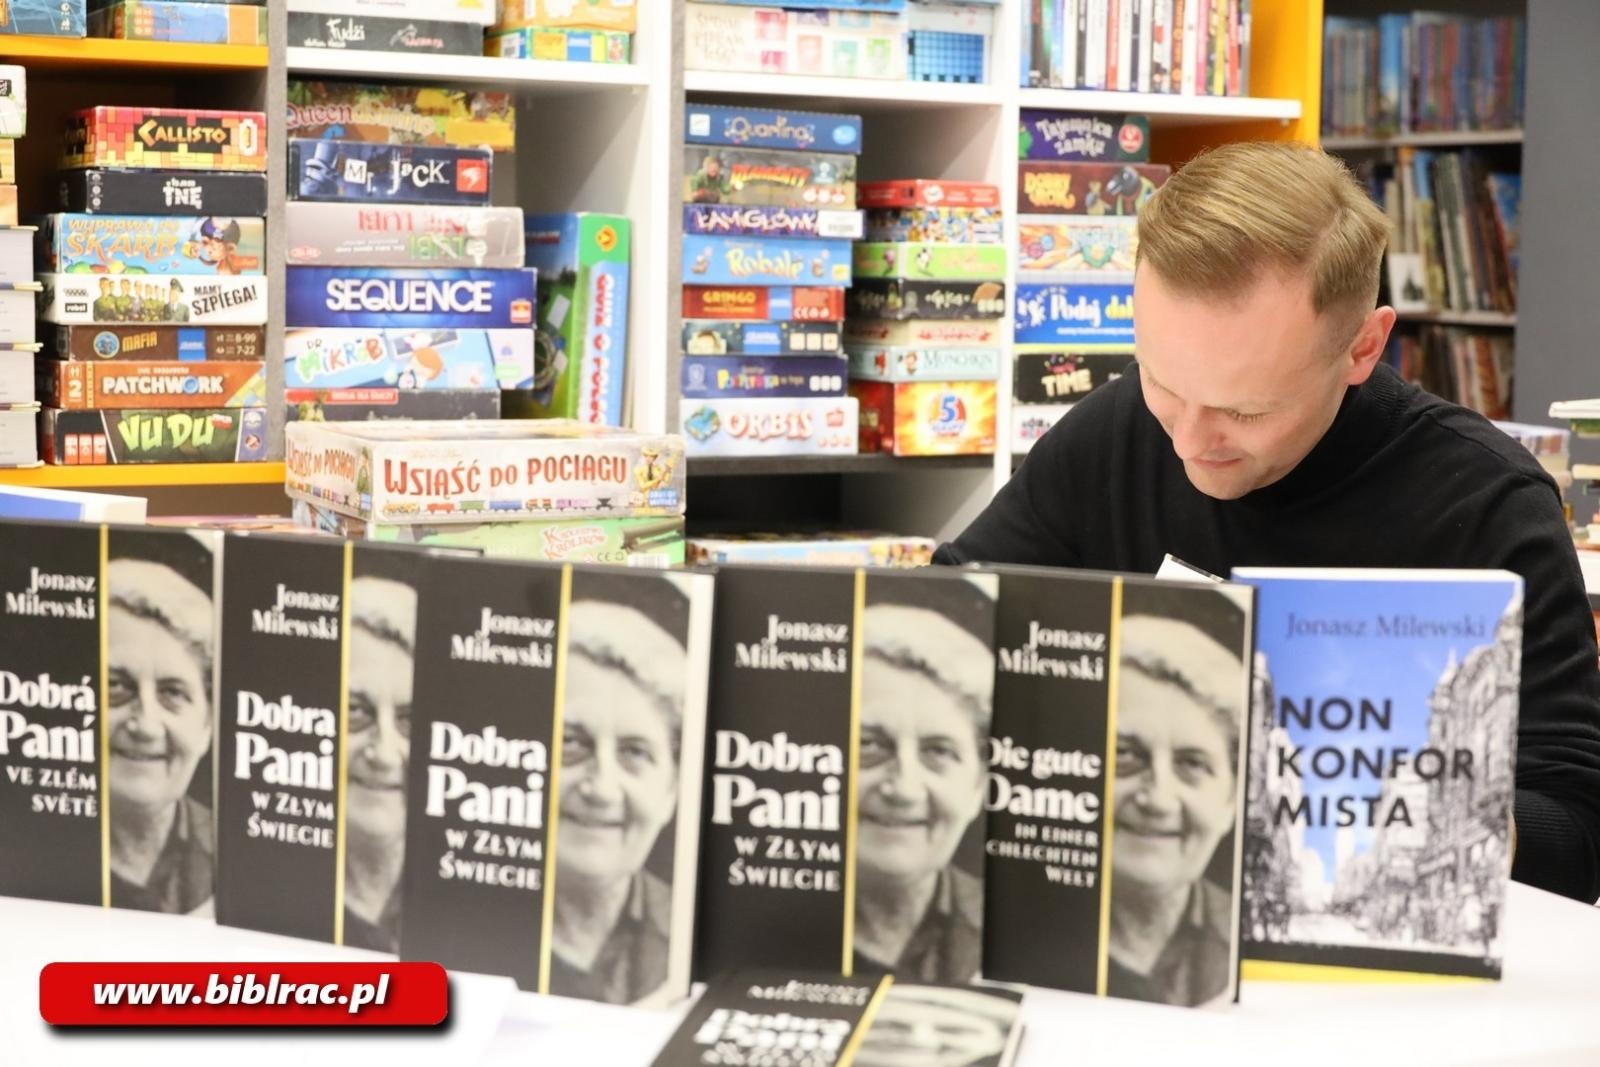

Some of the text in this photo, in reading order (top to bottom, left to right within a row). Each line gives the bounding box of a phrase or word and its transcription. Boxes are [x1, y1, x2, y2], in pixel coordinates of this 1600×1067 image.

[138, 119, 227, 147] CALLISTO
[66, 231, 179, 263] SKARB
[191, 285, 258, 316] SZPIEGA!
[194, 285, 221, 296] MAMY
[326, 278, 493, 313] SEQUENCE
[122, 331, 158, 353] MAFIA
[68, 379, 82, 398] 2
[103, 375, 224, 395] PATCHWORK
[1041, 368, 1093, 397] TIME
[940, 395, 956, 422] 5
[725, 410, 814, 441] ORBIS
[527, 454, 627, 485] POCIĄGU
[30, 566, 96, 593] Jonasz
[5, 592, 95, 620] Milewski
[276, 583, 340, 612] Jonasz
[252, 609, 339, 640] Milewski
[480, 607, 555, 638] Jonasz
[767, 614, 848, 645] Jonasz
[1029, 620, 1106, 652] Jonasz
[1286, 611, 1486, 639] Jonasz Milewski
[450, 633, 553, 669] Milewski
[735, 641, 848, 673] Milewski
[999, 647, 1104, 681] Milewski
[0, 670, 96, 712] Dobrá
[237, 690, 336, 738] Dobra
[1279, 697, 1393, 732] NON
[0, 709, 96, 763] Paní
[430, 721, 548, 772] Dobra
[234, 731, 335, 790] Pani
[714, 730, 844, 775] Dobra
[1031, 747, 1102, 780] gute
[1277, 746, 1474, 781] KONFOR
[6, 765, 97, 792] VE ZLÉM
[276, 795, 335, 820] ZŁYM
[425, 765, 545, 829] Pani
[711, 774, 841, 831] Pani
[984, 771, 1100, 824] Dame
[1272, 795, 1413, 828] MISTA
[247, 815, 335, 848] ŚWIECIE
[473, 830, 542, 861] ZŁYM
[1041, 825, 1099, 848] EINER
[765, 835, 841, 862] ZŁYM
[985, 839, 1098, 867] CHLECHTEN
[438, 852, 542, 890] ŚWIECIE
[728, 859, 841, 891] ŚWIECIE
[1045, 865, 1096, 888] WELT
